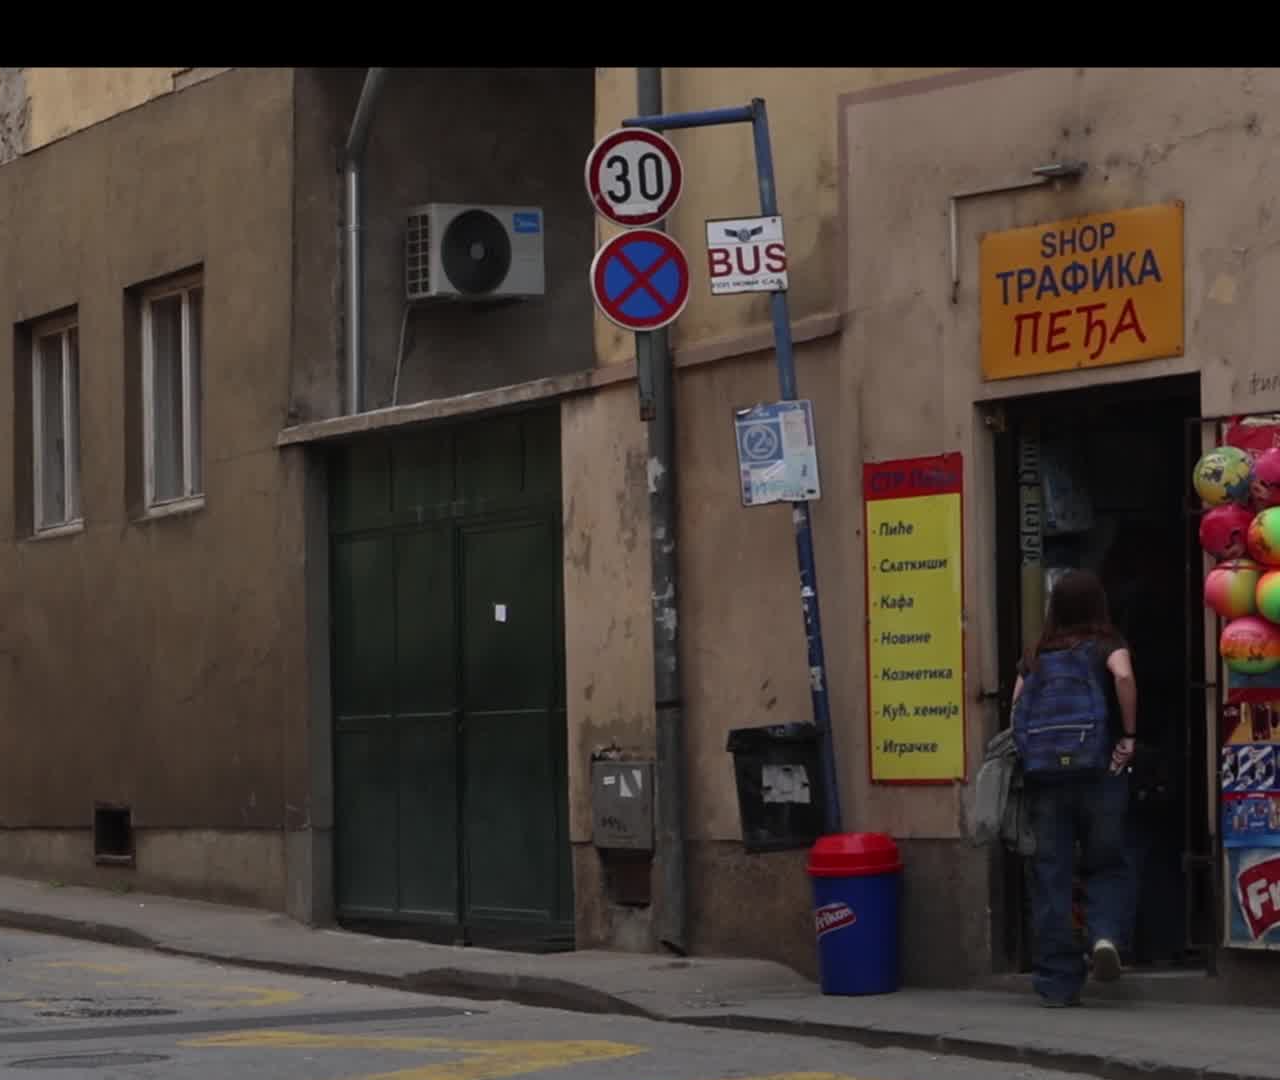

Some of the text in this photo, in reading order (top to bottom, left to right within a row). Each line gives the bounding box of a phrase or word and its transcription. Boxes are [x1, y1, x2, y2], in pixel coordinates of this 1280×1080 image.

[607, 152, 663, 203] 30
[1041, 222, 1115, 259] SHOP
[708, 244, 787, 277] BUS
[996, 249, 1162, 305] ТРАФИКА
[1014, 298, 1147, 361] ПЕЂА
[879, 520, 913, 537] Пиће
[880, 558, 947, 573] Слаткиши
[880, 593, 914, 612] Кафа
[881, 632, 931, 645] Новине
[881, 667, 953, 681] Козметика
[913, 702, 960, 719] хемија
[883, 739, 938, 758] Играчке
